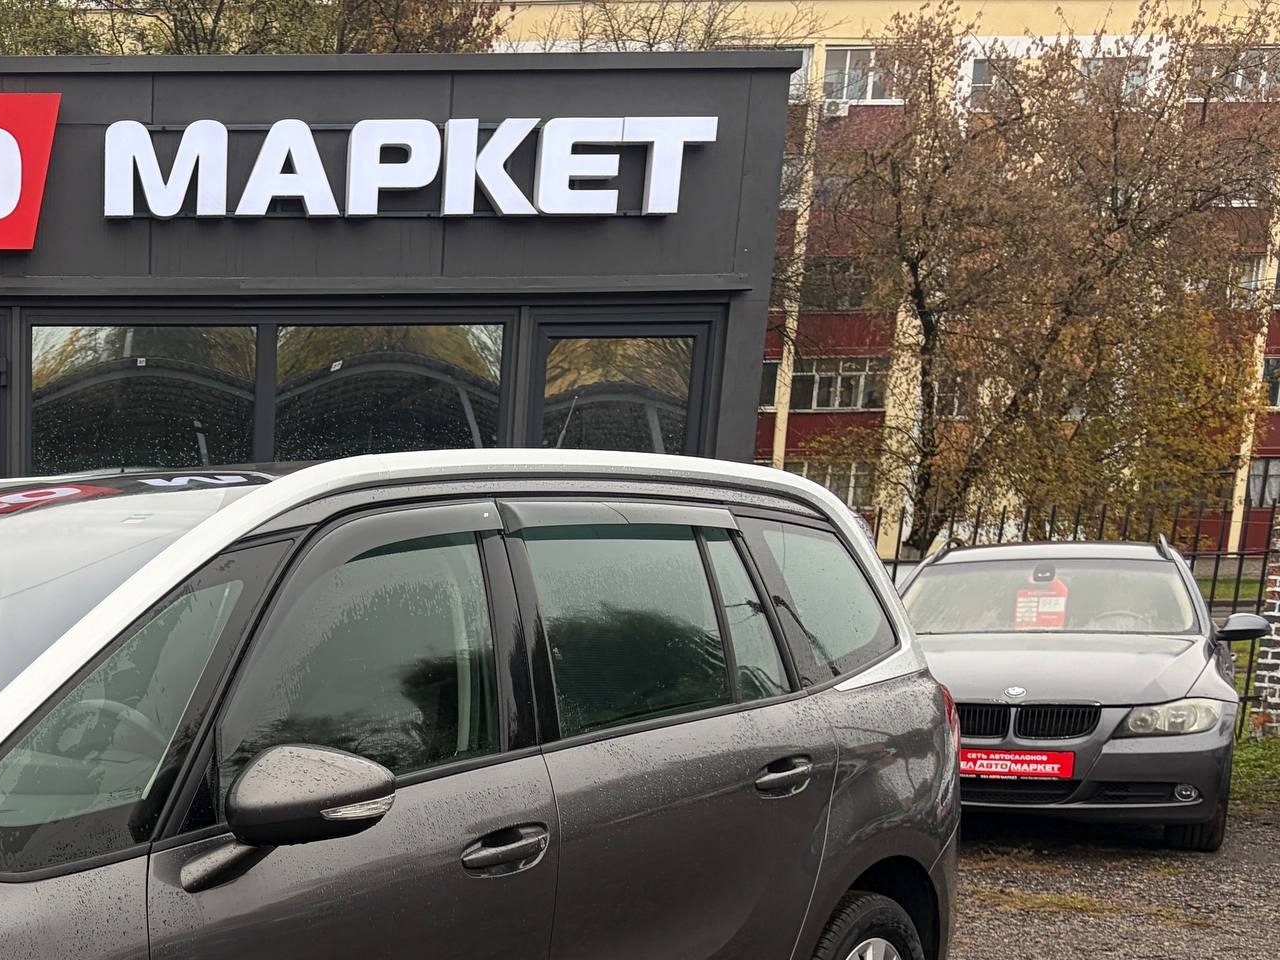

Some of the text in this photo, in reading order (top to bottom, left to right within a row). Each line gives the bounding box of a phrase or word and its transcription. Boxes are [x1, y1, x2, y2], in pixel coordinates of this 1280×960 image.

[104, 117, 718, 219] МАРКЕТ
[989, 753, 1048, 761] АВТОСАЛОНОВ
[960, 761, 975, 769] ЕЛ
